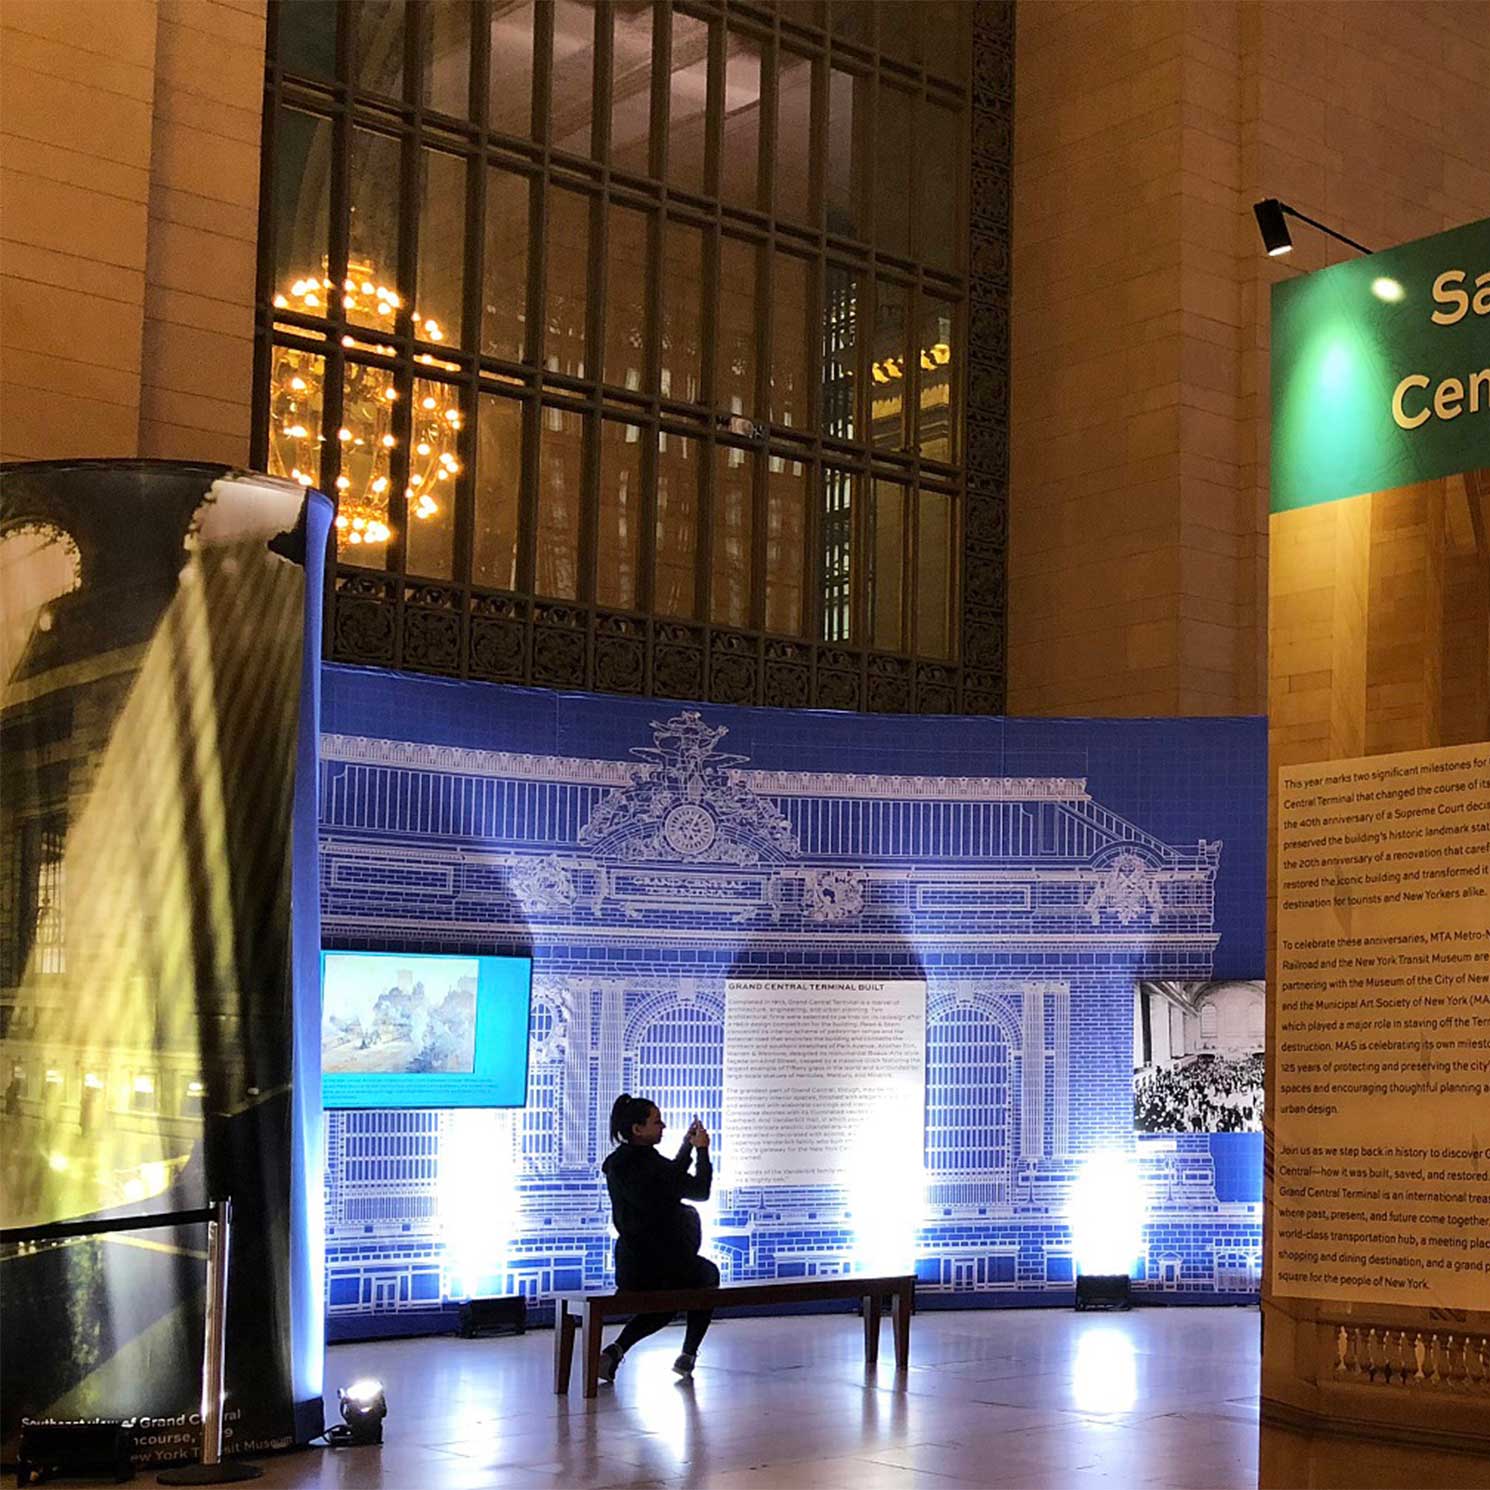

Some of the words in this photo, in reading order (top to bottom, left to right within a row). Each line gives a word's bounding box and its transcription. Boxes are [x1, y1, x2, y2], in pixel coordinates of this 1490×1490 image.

[1284, 777, 1302, 787] This
[1303, 777, 1323, 788] year
[1324, 772, 1352, 783] marks
[1353, 770, 1370, 780] two
[1371, 765, 1418, 781] significant
[1419, 760, 1472, 774] milestones
[1473, 758, 1486, 768] for
[1284, 796, 1316, 808] Central
[1317, 792, 1354, 805] Terminal
[1356, 790, 1374, 801] that
[1375, 787, 1415, 802] changed
[1416, 785, 1432, 795] the
[1433, 785, 1466, 794] course
[1467, 781, 1477, 790] of
[1284, 817, 1298, 827] the
[1299, 815, 1321, 826] 40th
[1322, 810, 1374, 827] anniversary
[1375, 810, 1385, 819] of
[1394, 805, 1436, 820] Supreme
[1437, 802, 1464, 814] Court
[1284, 835, 1326, 850] preserved
[1328, 834, 1343, 844] the
[1344, 830, 1387, 845] building's
[1388, 827, 1423, 839] historic
[1425, 823, 1469, 836] landmark
[1284, 858, 1297, 868] the
[1298, 856, 1320, 867] 20th
[1320, 852, 1372, 868] anniversary
[1374, 851, 1384, 861] of
[1392, 847, 1442, 859] renovation
[1443, 845, 1463, 856] that
[1283, 876, 1319, 887] restored
[1320, 875, 1335, 885] the
[1335, 873, 1363, 884] iconic
[1365, 870, 1401, 884] building
[1402, 869, 1420, 879] and
[1422, 865, 1480, 878] transformed
[1481, 865, 1488, 874] it
[1282, 896, 1331, 908] destination
[1333, 895, 1346, 905] for
[1347, 893, 1382, 904] tourists
[1383, 892, 1401, 902] and
[1402, 891, 1424, 901] New
[1425, 889, 1460, 900] Yorkers
[1462, 888, 1486, 898] alike.
[1282, 939, 1292, 948] To
[1294, 937, 1335, 948] celebrate
[1337, 936, 1362, 946] these
[1363, 933, 1428, 946] anniversaries,
[1430, 931, 1452, 941] MTA
[728, 983, 762, 991] GRAND
[764, 983, 808, 991] CENTRAL
[810, 983, 856, 991] TERMINAL
[1282, 1000, 1298, 1009] and
[1299, 999, 1314, 1008] the
[1315, 998, 1358, 1011] Municipal
[1359, 998, 1374, 1007] Art
[1375, 997, 1411, 1009] Society
[1412, 996, 1422, 1006] of
[1424, 996, 1445, 1005] New
[1446, 995, 1468, 1005] York
[1335, 1040, 1357, 1049] MAS
[1358, 1040, 1367, 1049] is
[1368, 1039, 1420, 1052] celebrating
[1421, 1039, 1434, 1048] its
[1281, 1085, 1311, 1094] spaces
[1313, 1082, 1330, 1091] and
[1331, 1082, 1388, 1094] encouraging
[1389, 1082, 1438, 1094] thoughtful
[1439, 1082, 1481, 1094] planning
[1279, 1186, 1306, 1196] Grand
[1307, 1187, 1340, 1197] Central
[1342, 1188, 1380, 1198] Terminal
[1381, 1189, 1390, 1198] is
[1405, 1190, 1467, 1201] international
[1279, 1207, 1305, 1217] where
[1306, 1208, 1329, 1221] past,
[1330, 1209, 1368, 1223] present,
[1369, 1211, 1387, 1221] and
[1388, 1212, 1417, 1222] future
[1278, 1274, 1308, 1284] square
[1309, 1272, 1322, 1282] for
[1323, 1273, 1338, 1283] the
[1339, 1274, 1371, 1287] people
[1372, 1276, 1383, 1285] of
[1384, 1276, 1406, 1286] New
[139, 1414, 186, 1429] Grand
[154, 1449, 188, 1462] York
